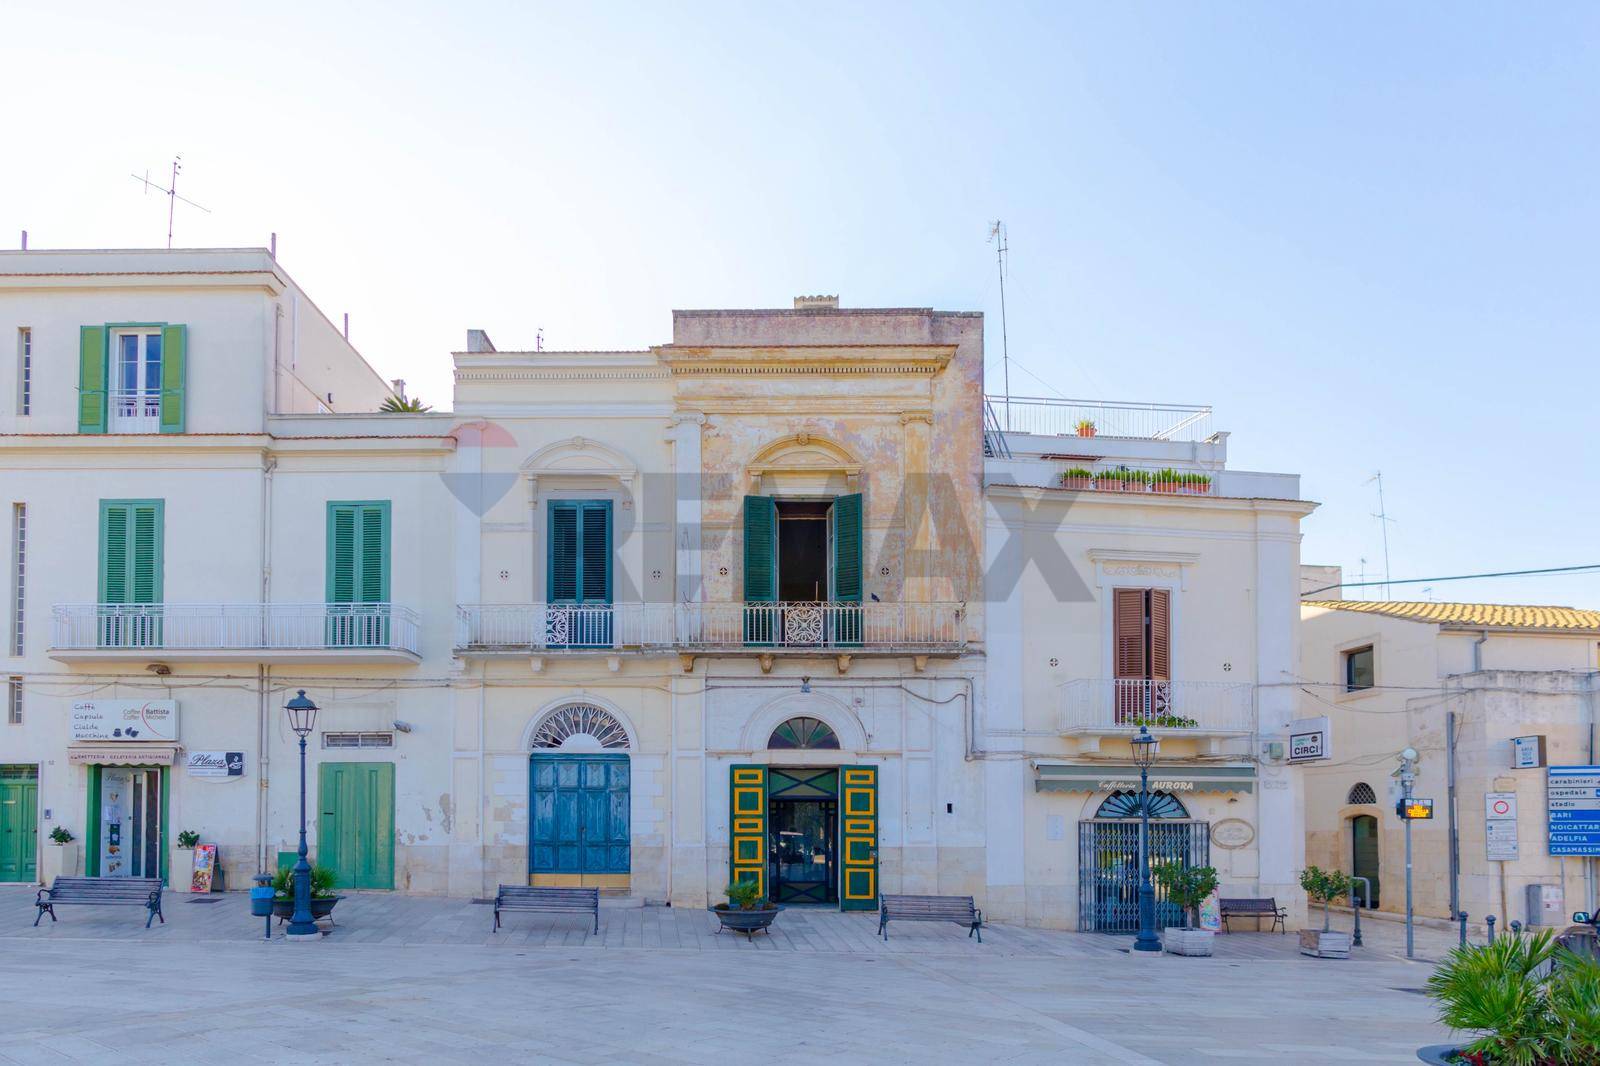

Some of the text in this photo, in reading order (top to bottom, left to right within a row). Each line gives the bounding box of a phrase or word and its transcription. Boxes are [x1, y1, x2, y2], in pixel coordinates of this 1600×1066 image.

[1294, 745, 1319, 755] CIRCI
[1151, 781, 1194, 790] AURORA
[1550, 789, 1587, 797] ospedale
